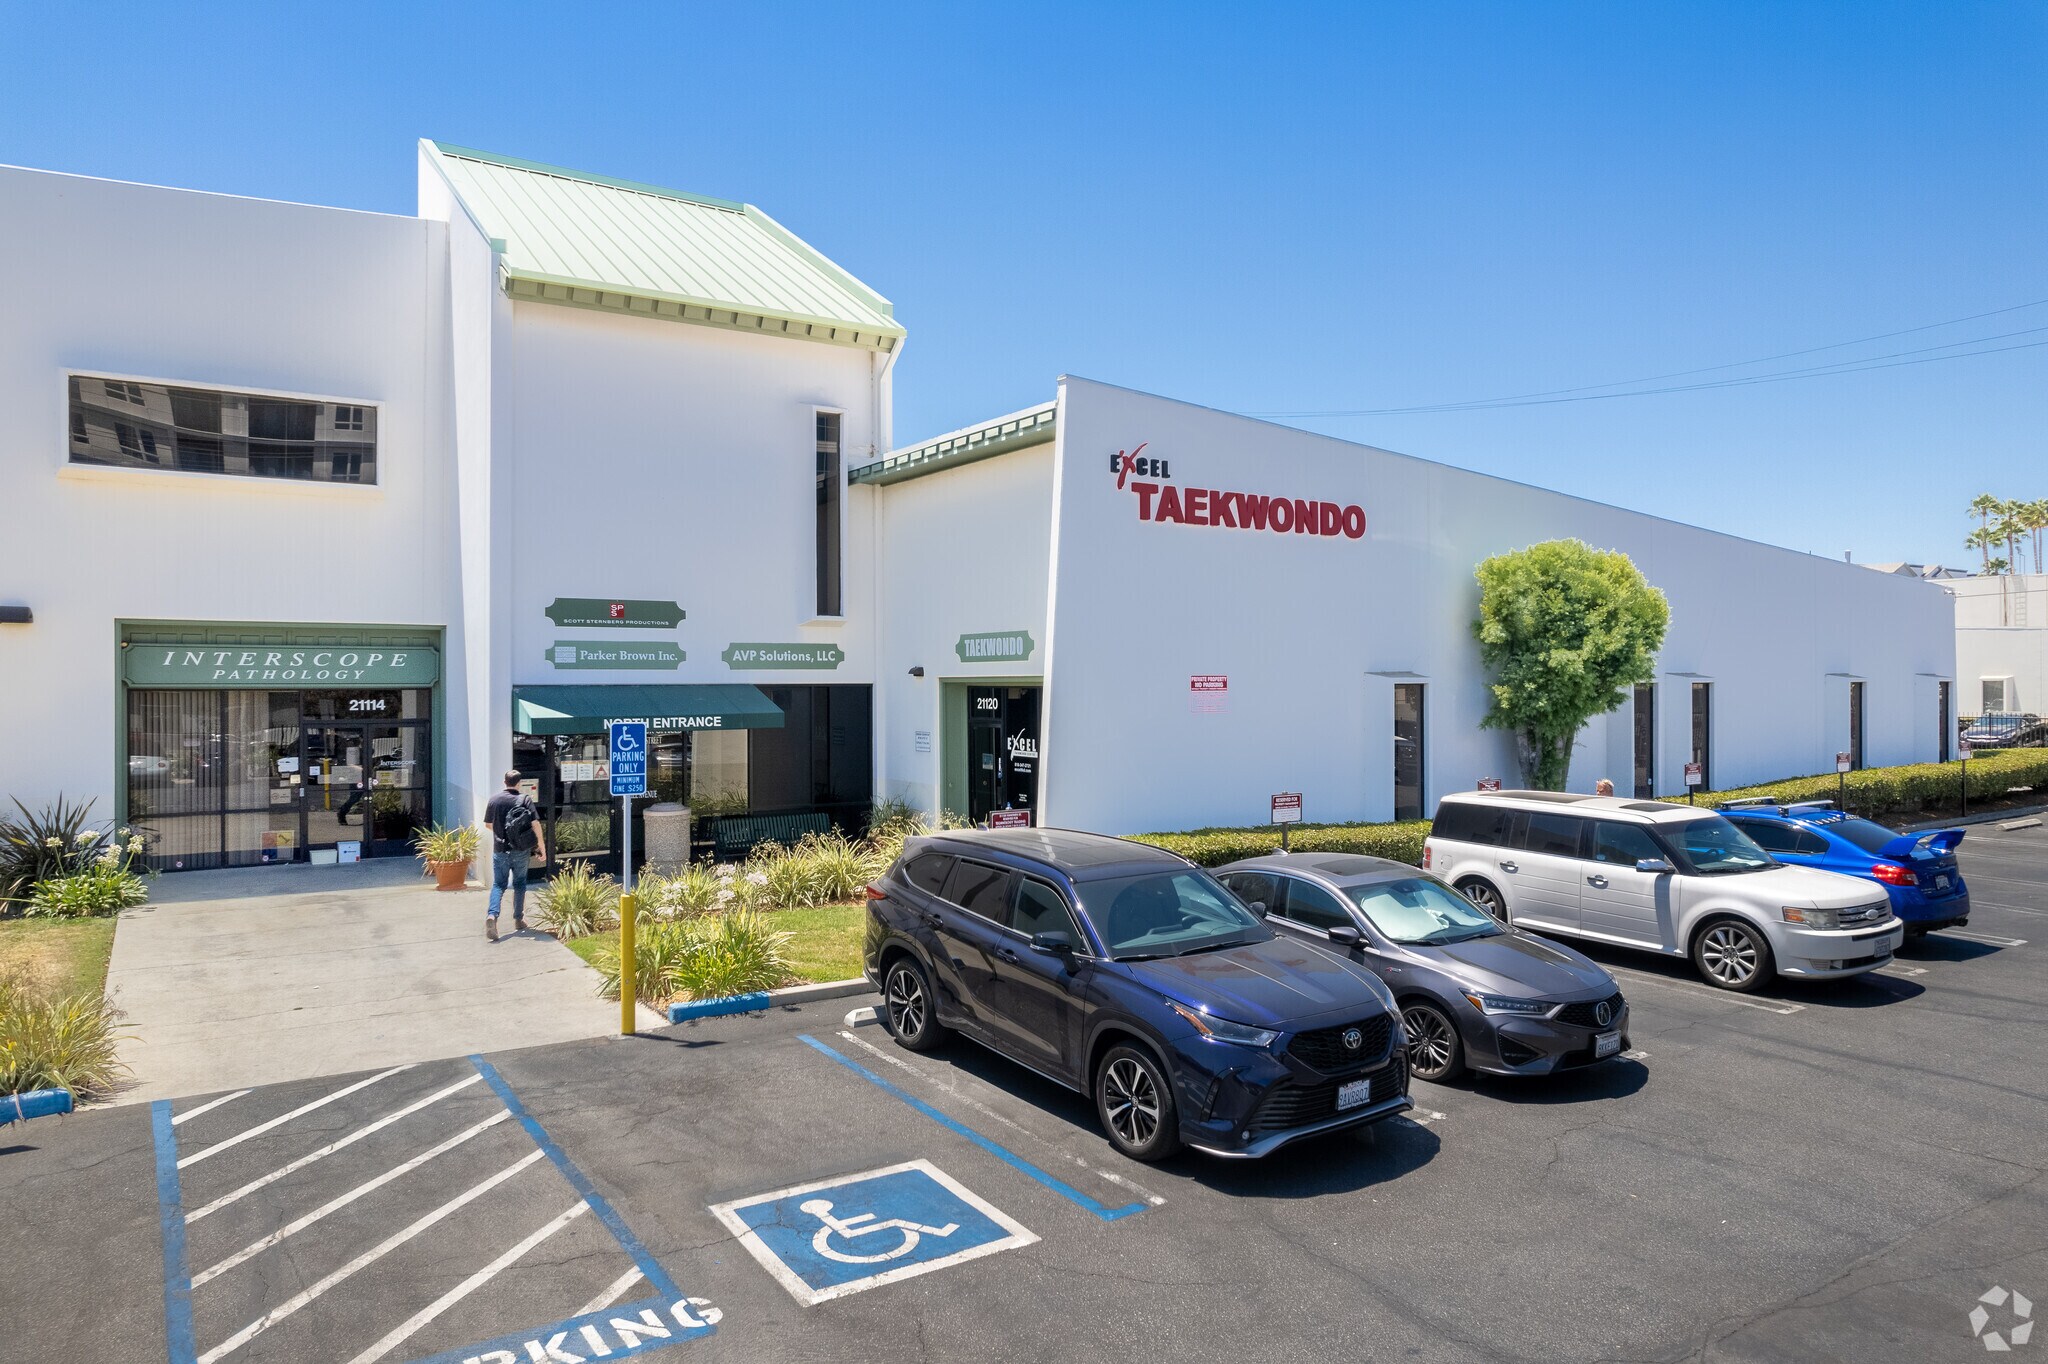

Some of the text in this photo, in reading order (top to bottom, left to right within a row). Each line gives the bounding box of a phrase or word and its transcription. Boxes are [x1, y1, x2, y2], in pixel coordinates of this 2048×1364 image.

[1110, 442, 1170, 490] EXCEL
[1131, 482, 1366, 539] TAEKWONDO
[964, 636, 1024, 657] TAEKWONDO
[162, 651, 408, 668] INTERSCOPE
[580, 650, 678, 661] Parker Brown Inc.
[732, 650, 836, 663] AVP Solutions, LLC
[212, 669, 366, 680] PATHOLOGY
[349, 699, 386, 711] 21114
[977, 698, 998, 709] 21120
[653, 716, 722, 728] ENTRANCE
[1007, 728, 1037, 761] EXCEL
[612, 751, 645, 762] PARKING
[619, 763, 639, 774] ONLY
[627, 784, 643, 792] $250
